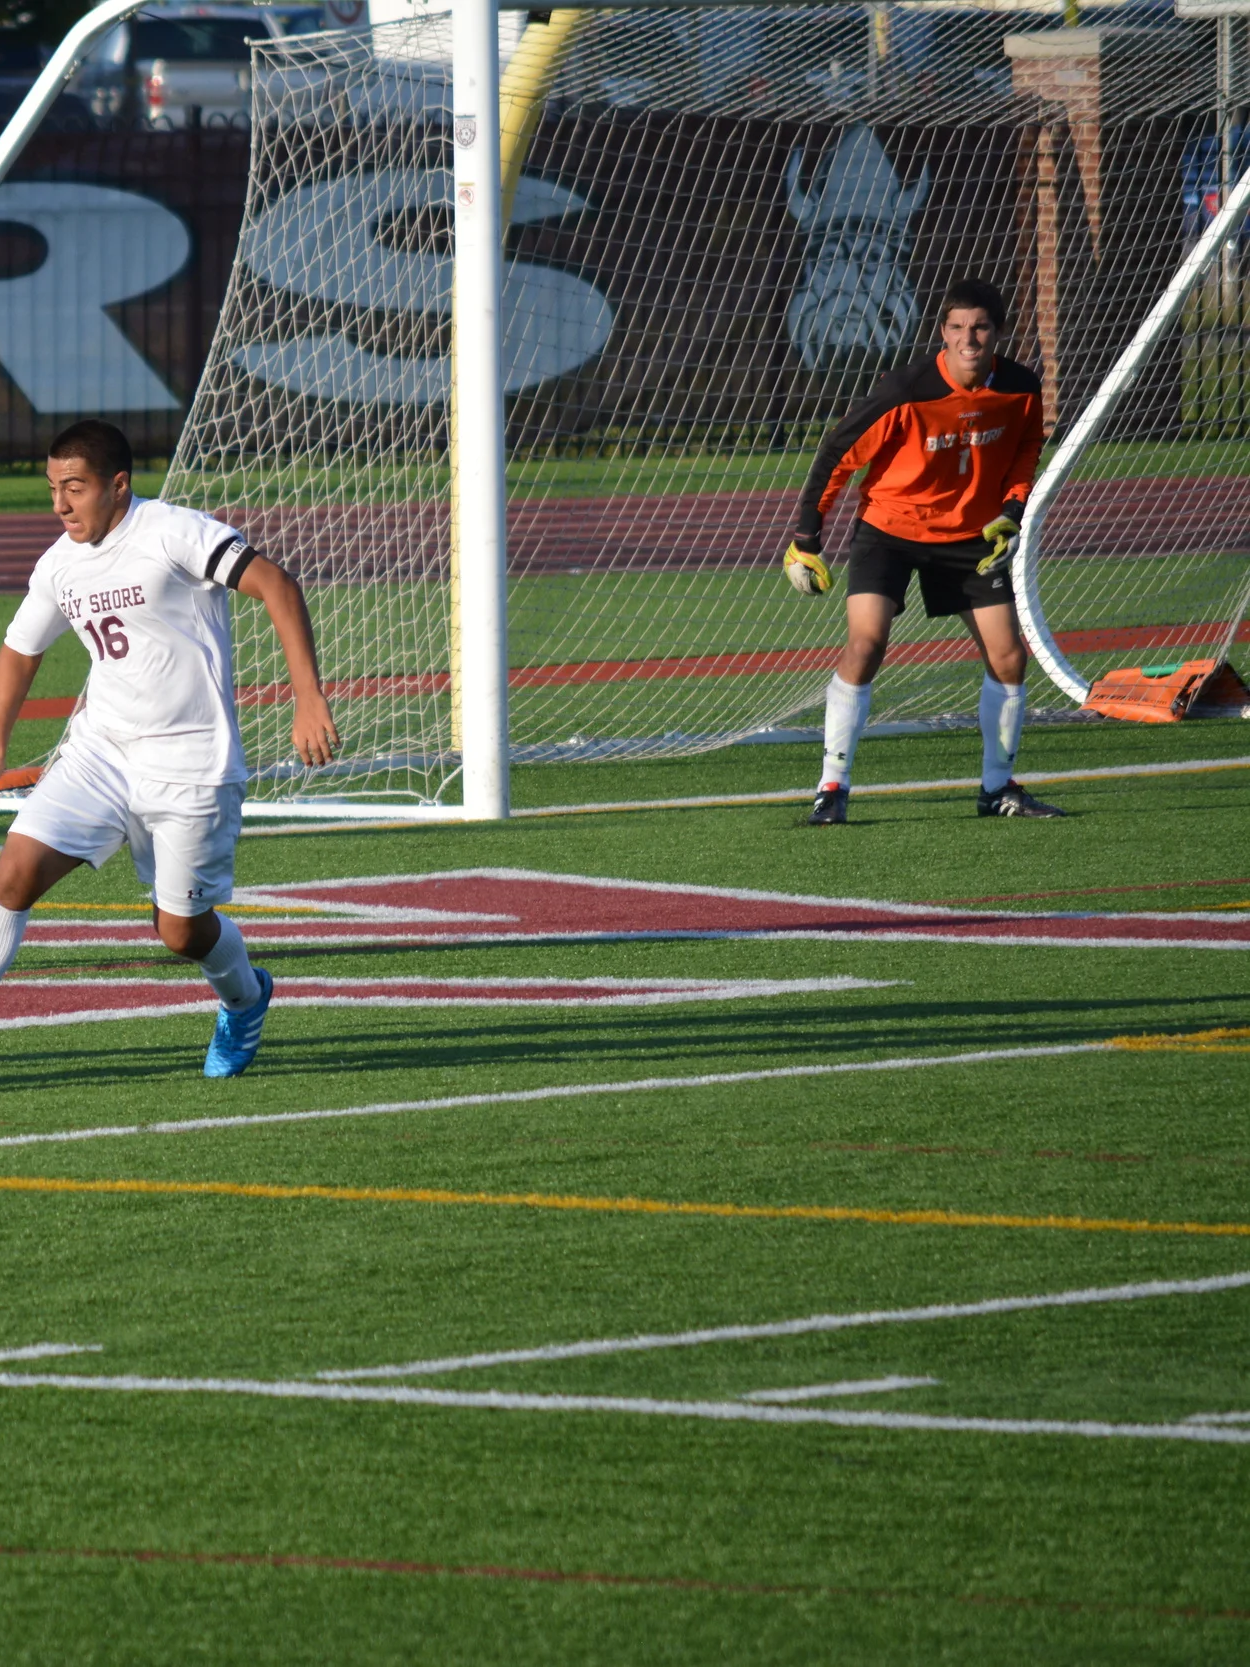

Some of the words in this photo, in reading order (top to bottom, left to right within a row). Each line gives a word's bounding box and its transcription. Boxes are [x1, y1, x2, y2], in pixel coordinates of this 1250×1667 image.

[926, 433, 957, 452] BAY
[958, 448, 971, 475] 1
[89, 585, 145, 614] SHORE
[83, 614, 130, 661] 16
